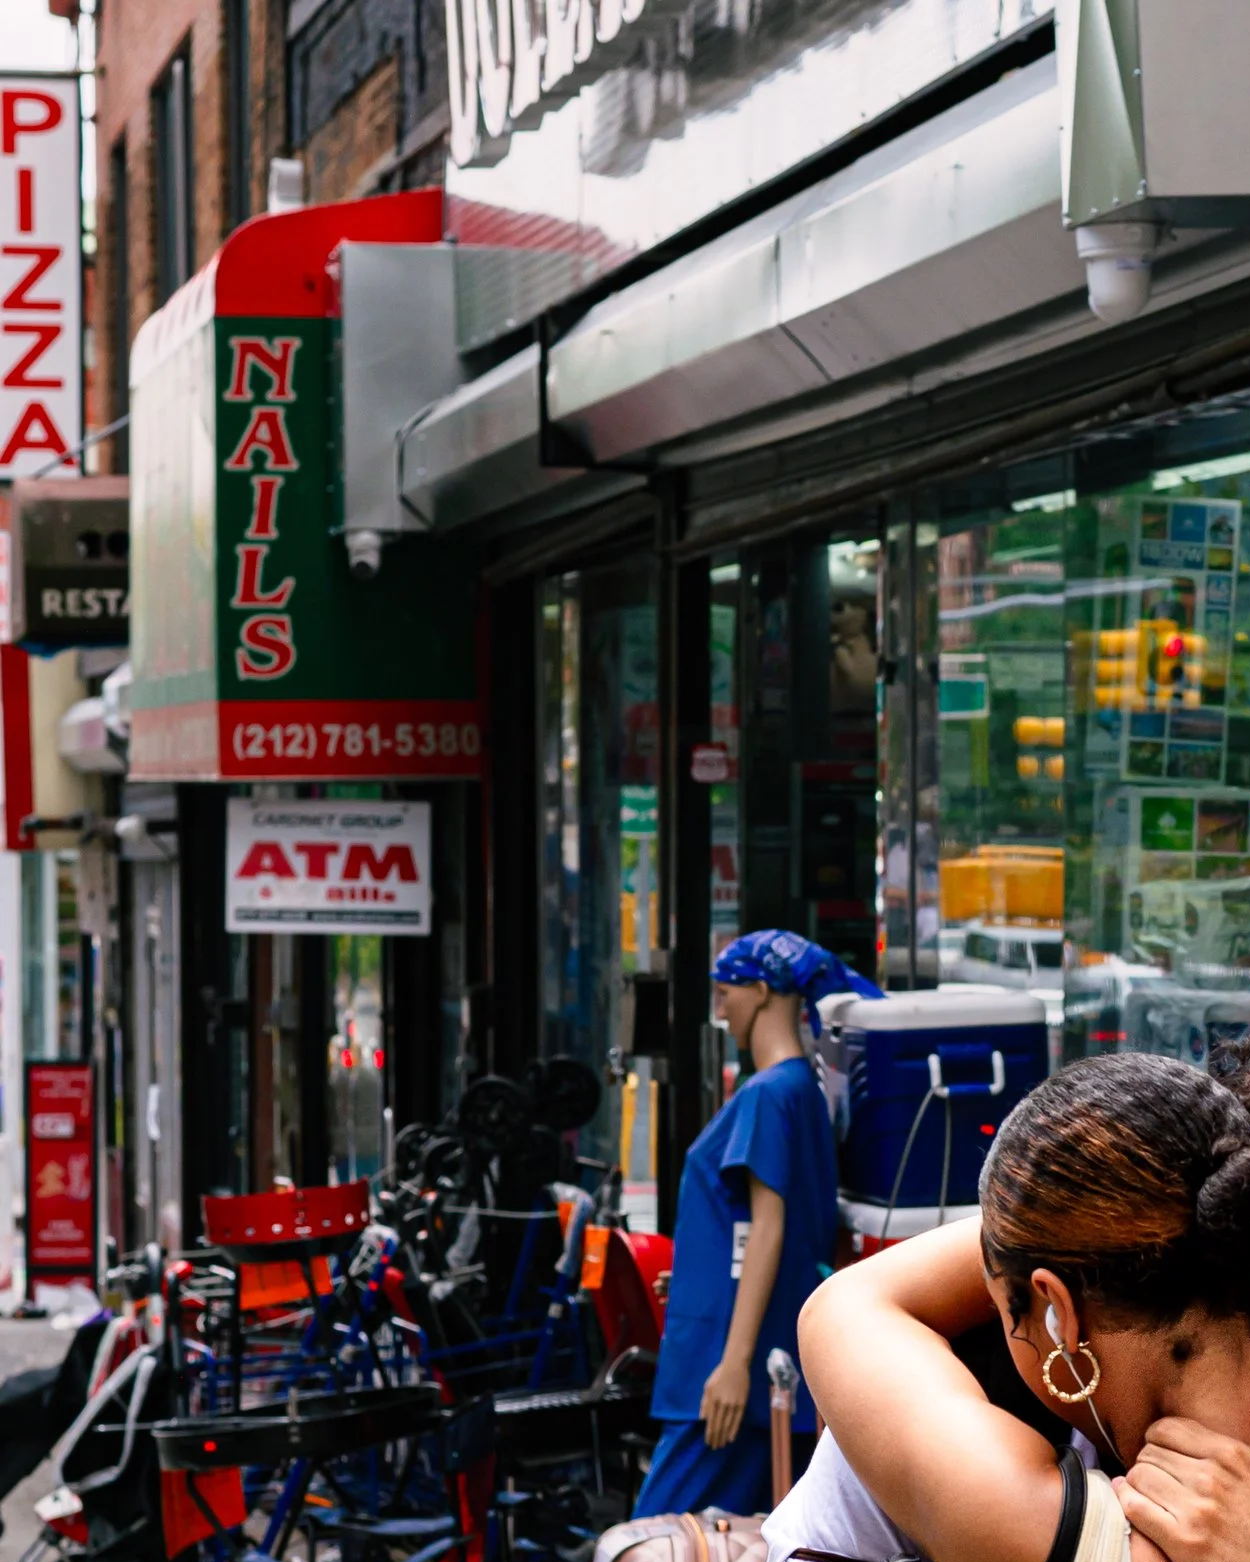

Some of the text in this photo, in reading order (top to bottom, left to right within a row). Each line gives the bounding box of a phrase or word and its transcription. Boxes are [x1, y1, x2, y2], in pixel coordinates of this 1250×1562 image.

[1, 90, 75, 466] PIZZA
[223, 336, 300, 681] NAILS
[232, 722, 481, 761] (212) 781-5380
[234, 839, 420, 883] ATM
